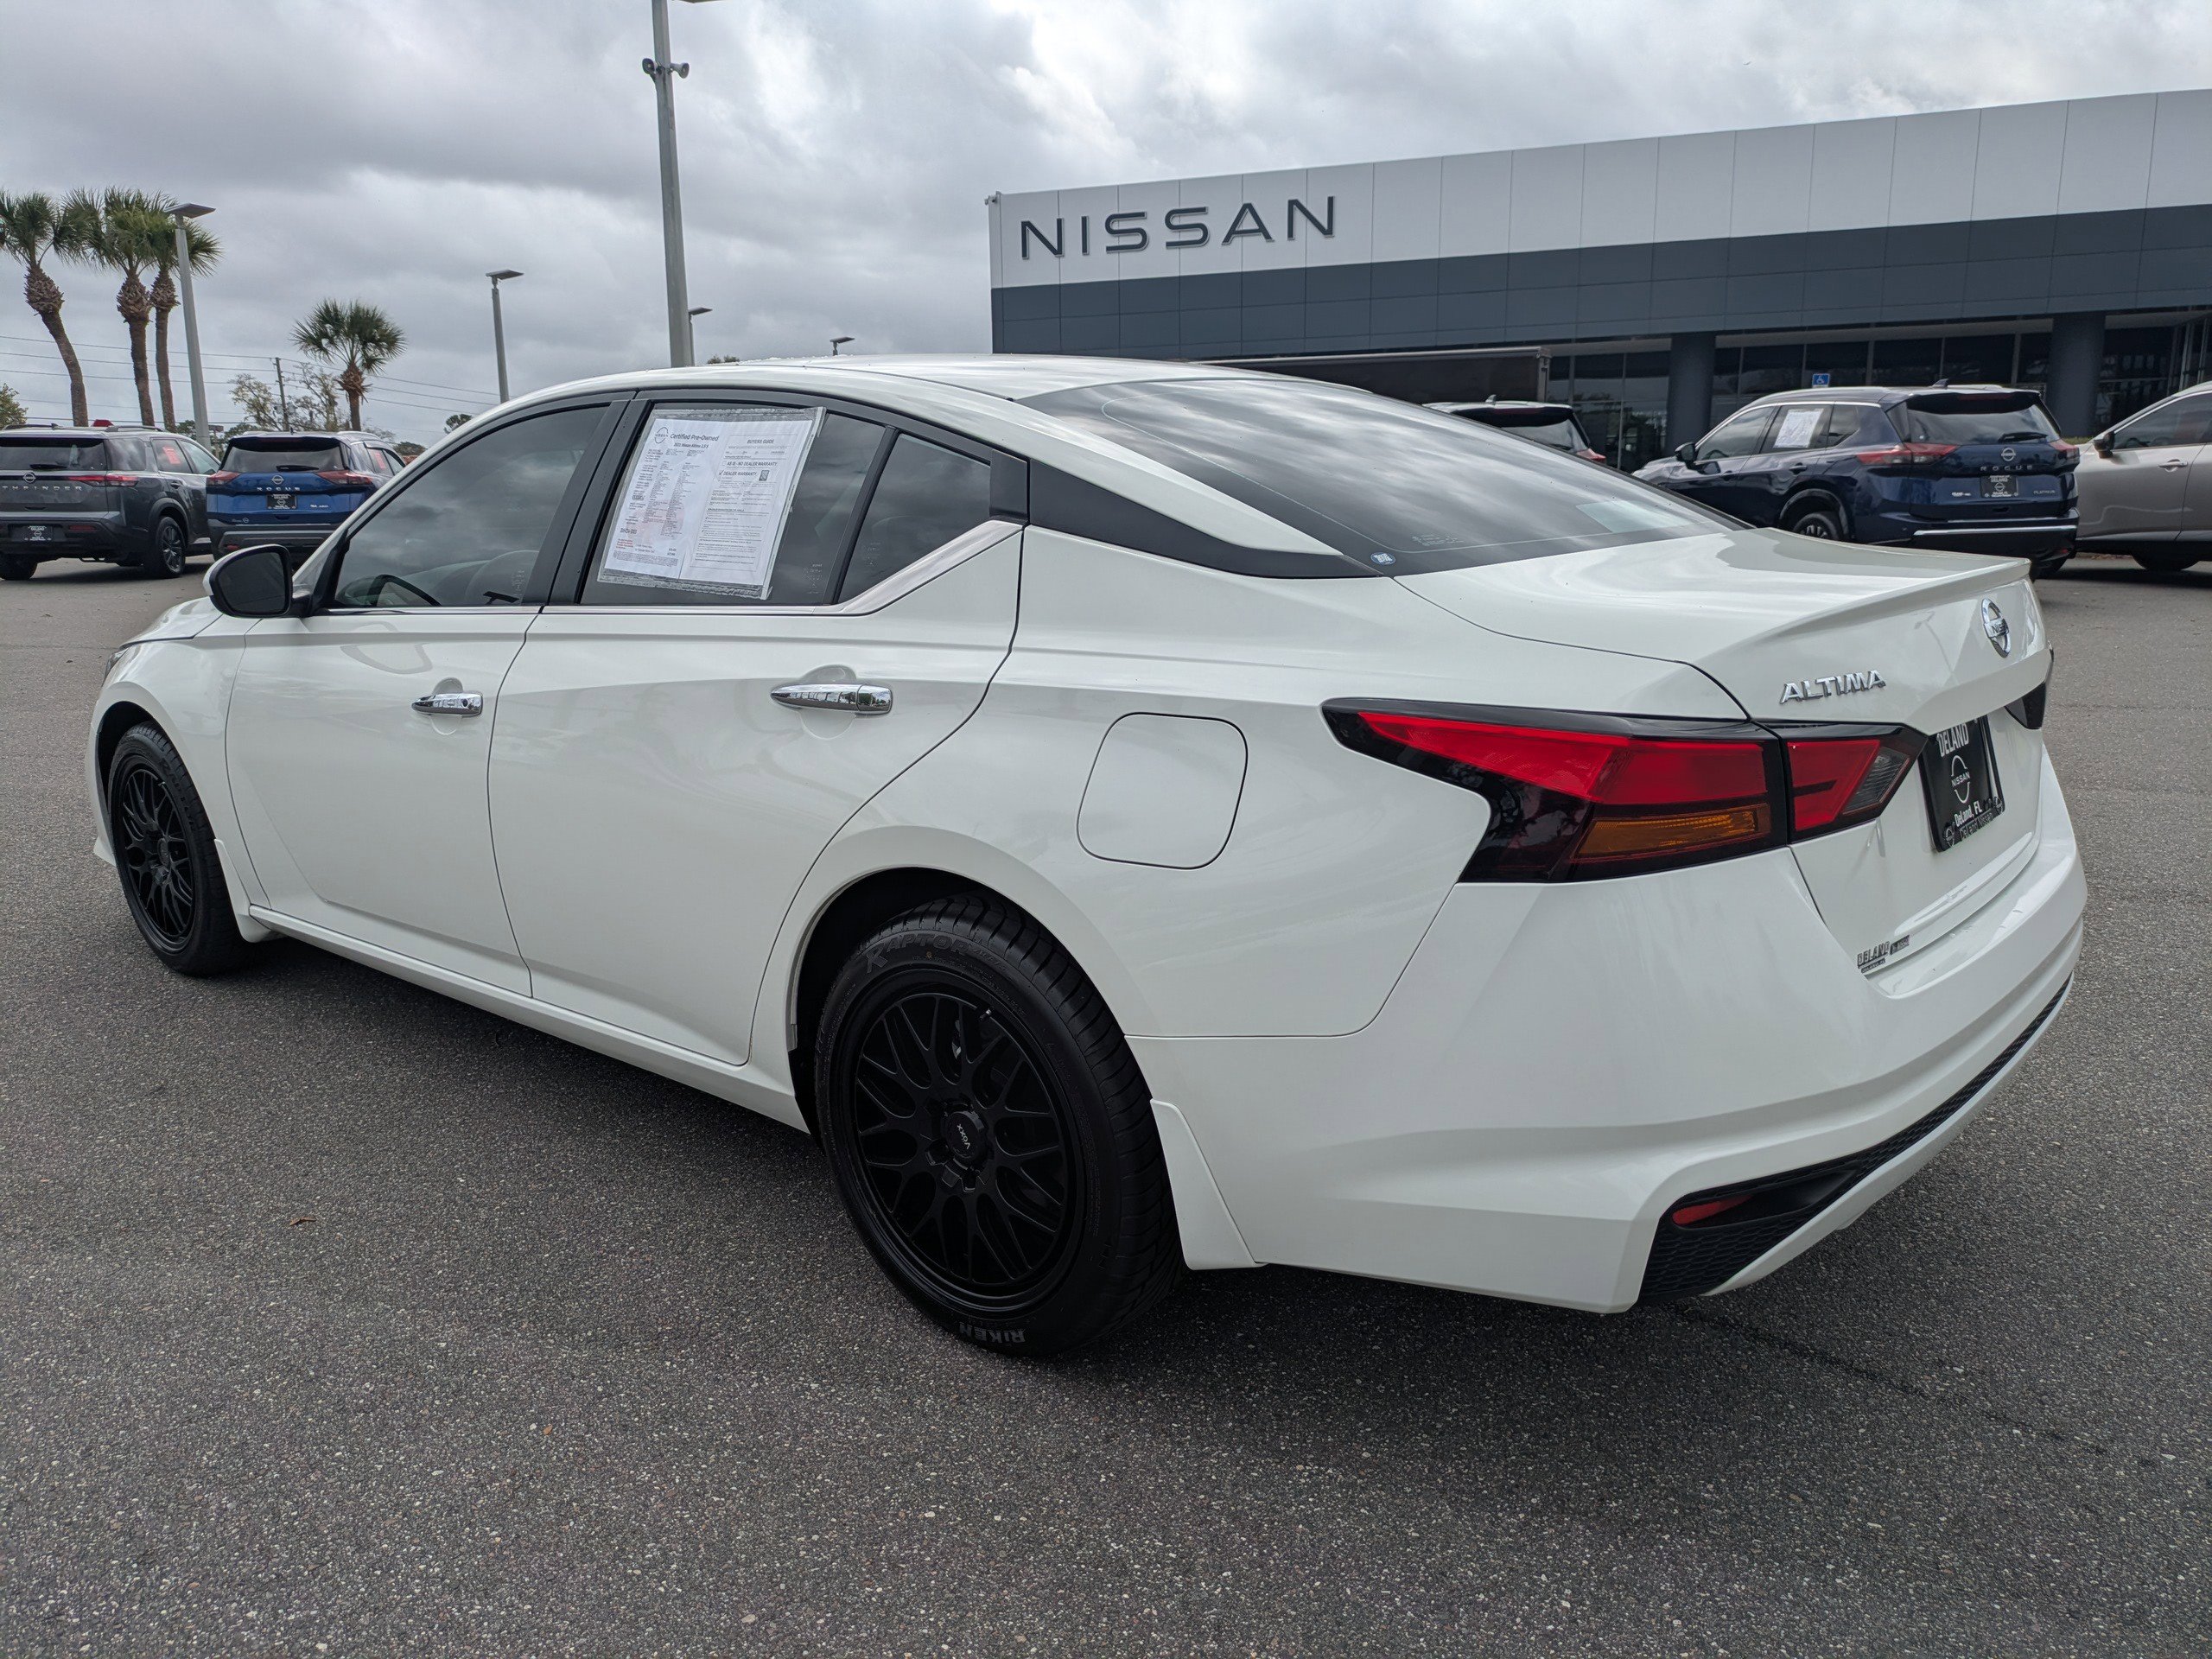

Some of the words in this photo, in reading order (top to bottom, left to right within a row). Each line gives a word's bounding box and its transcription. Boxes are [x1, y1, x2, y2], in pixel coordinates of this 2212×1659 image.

[1020, 195, 1334, 260] NISSAN
[1779, 670, 1886, 704] ALTIMA
[1936, 723, 1969, 758] DELAND
[1951, 771, 1971, 786] NISSAN
[1954, 804, 1975, 827] DeLand,
[1974, 801, 1983, 815] FL
[865, 933, 969, 973] RAPTOR
[958, 1322, 1026, 1344] RIKEN
